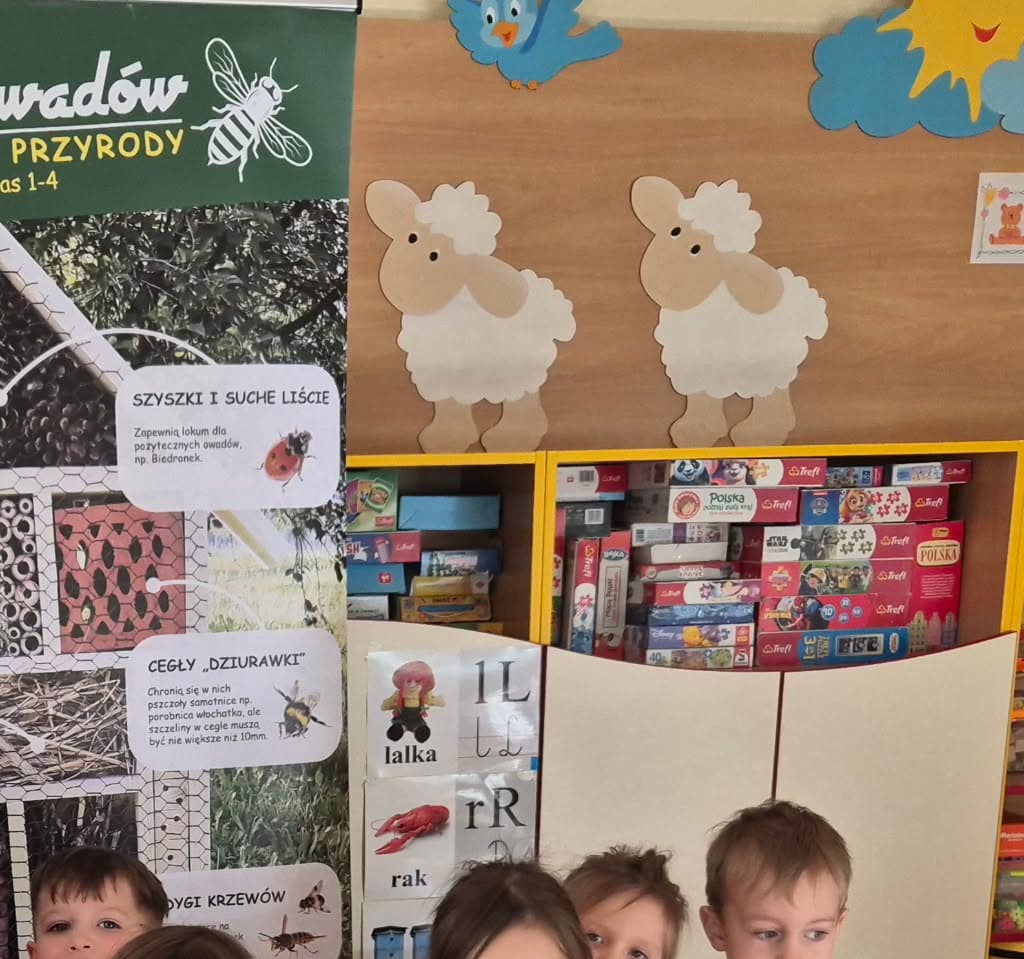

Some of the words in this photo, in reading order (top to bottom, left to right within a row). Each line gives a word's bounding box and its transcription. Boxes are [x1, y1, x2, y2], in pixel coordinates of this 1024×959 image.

[12, 128, 185, 164] PRZYRODY
[28, 171, 58, 193] 1-4
[133, 392, 203, 407] SZYSZKI
[210, 391, 218, 405] I
[225, 390, 277, 405] SUCHE
[282, 387, 330, 405] LIŚCIE
[182, 427, 209, 438] lokum
[212, 425, 227, 436] dla
[148, 659, 196, 673] CEGŁY
[147, 686, 183, 698] Chronią
[186, 686, 199, 696] się
[212, 684, 231, 694] nich
[148, 699, 186, 710] pszczoły
[190, 697, 237, 707] samotnice
[148, 710, 193, 723] porobnica
[247, 707, 261, 717] ale
[148, 723, 191, 735] szczeliny
[204, 720, 228, 733] cegle
[231, 720, 260, 731] muszą
[149, 735, 166, 748] być
[168, 735, 182, 745] nie
[185, 733, 221, 746] większe
[384, 743, 438, 765] lalka
[390, 869, 427, 889] rak
[208, 888, 286, 909] KRZEWÓW
